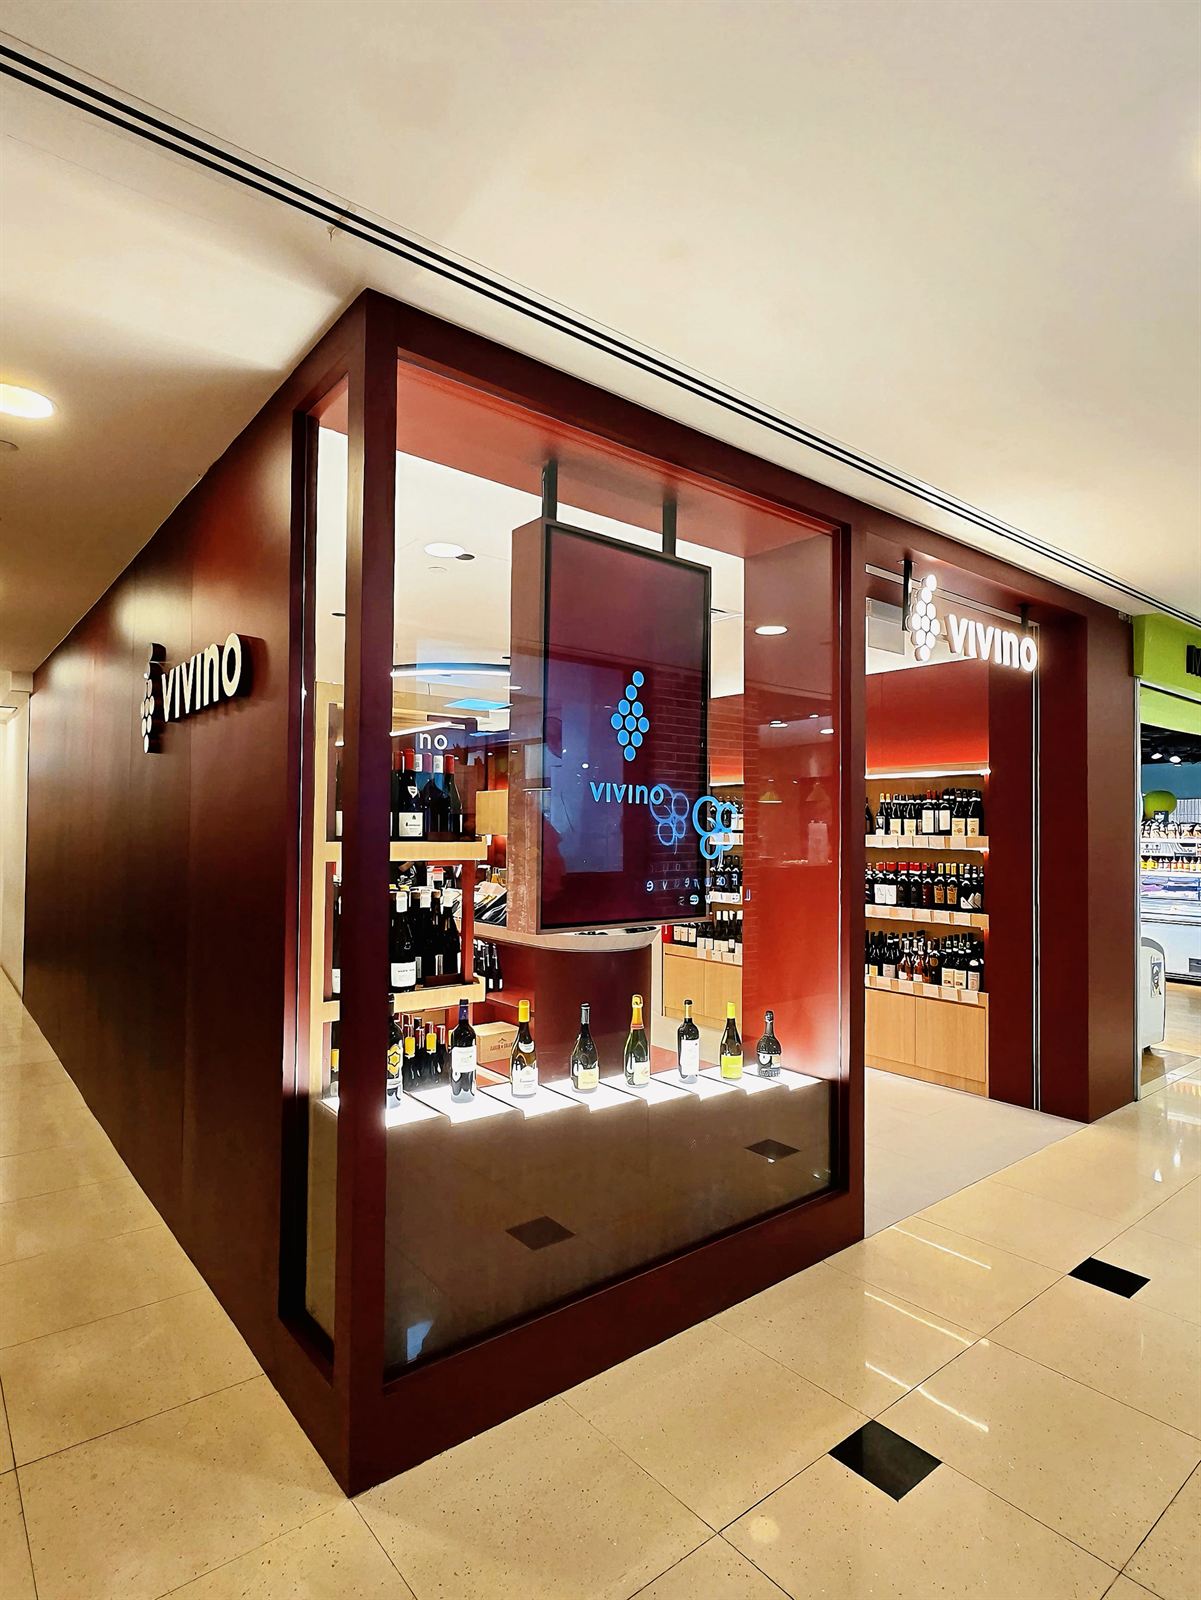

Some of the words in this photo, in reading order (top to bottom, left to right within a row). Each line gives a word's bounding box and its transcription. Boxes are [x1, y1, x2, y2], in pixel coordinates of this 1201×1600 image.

[948, 613, 1038, 672] vivino
[161, 632, 242, 723] vivino
[419, 733, 448, 750] no
[590, 782, 664, 805] vivino
